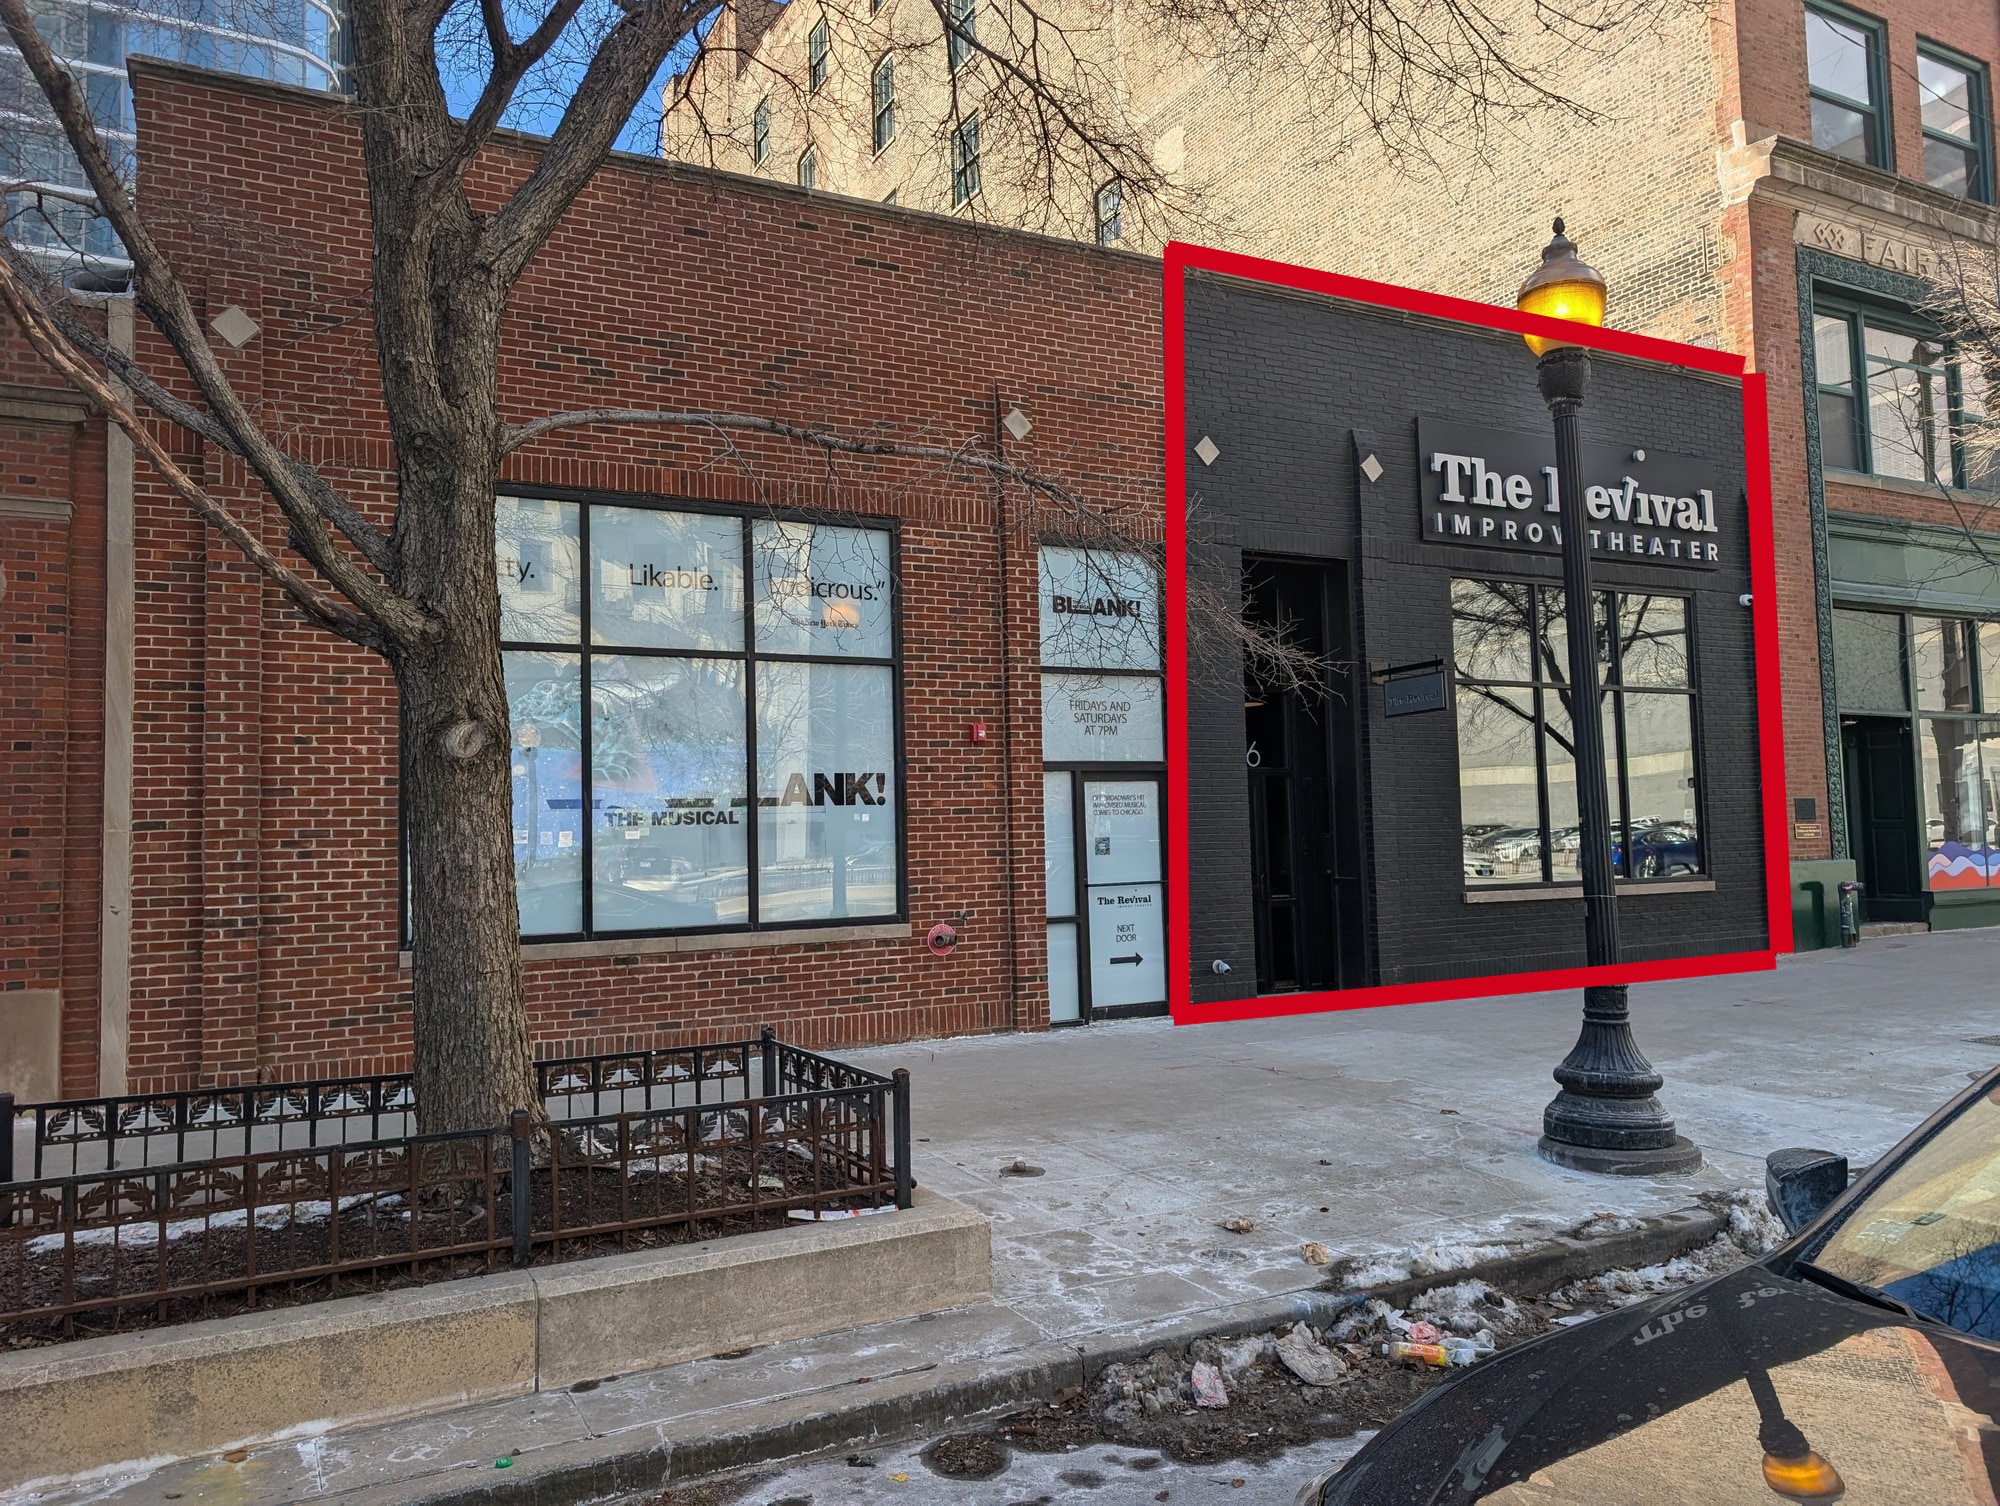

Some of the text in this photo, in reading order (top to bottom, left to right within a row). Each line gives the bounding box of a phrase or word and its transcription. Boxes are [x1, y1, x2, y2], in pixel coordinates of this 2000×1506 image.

[1859, 231, 1931, 276] FAIR
[1430, 452, 1533, 510] The
[1589, 529, 1719, 562] THEATER
[629, 563, 719, 591] Likable.
[820, 620, 836, 629] York
[1069, 700, 1131, 712] FRIDAYS AND
[1073, 712, 1128, 724] SATURDAYS
[1084, 725, 1118, 736] AT 7PM
[603, 810, 739, 827] THE MUSICAL
[1097, 892, 1152, 905] The Revival
[1117, 924, 1135, 933] NEXT
[1115, 934, 1137, 943] DOOR
